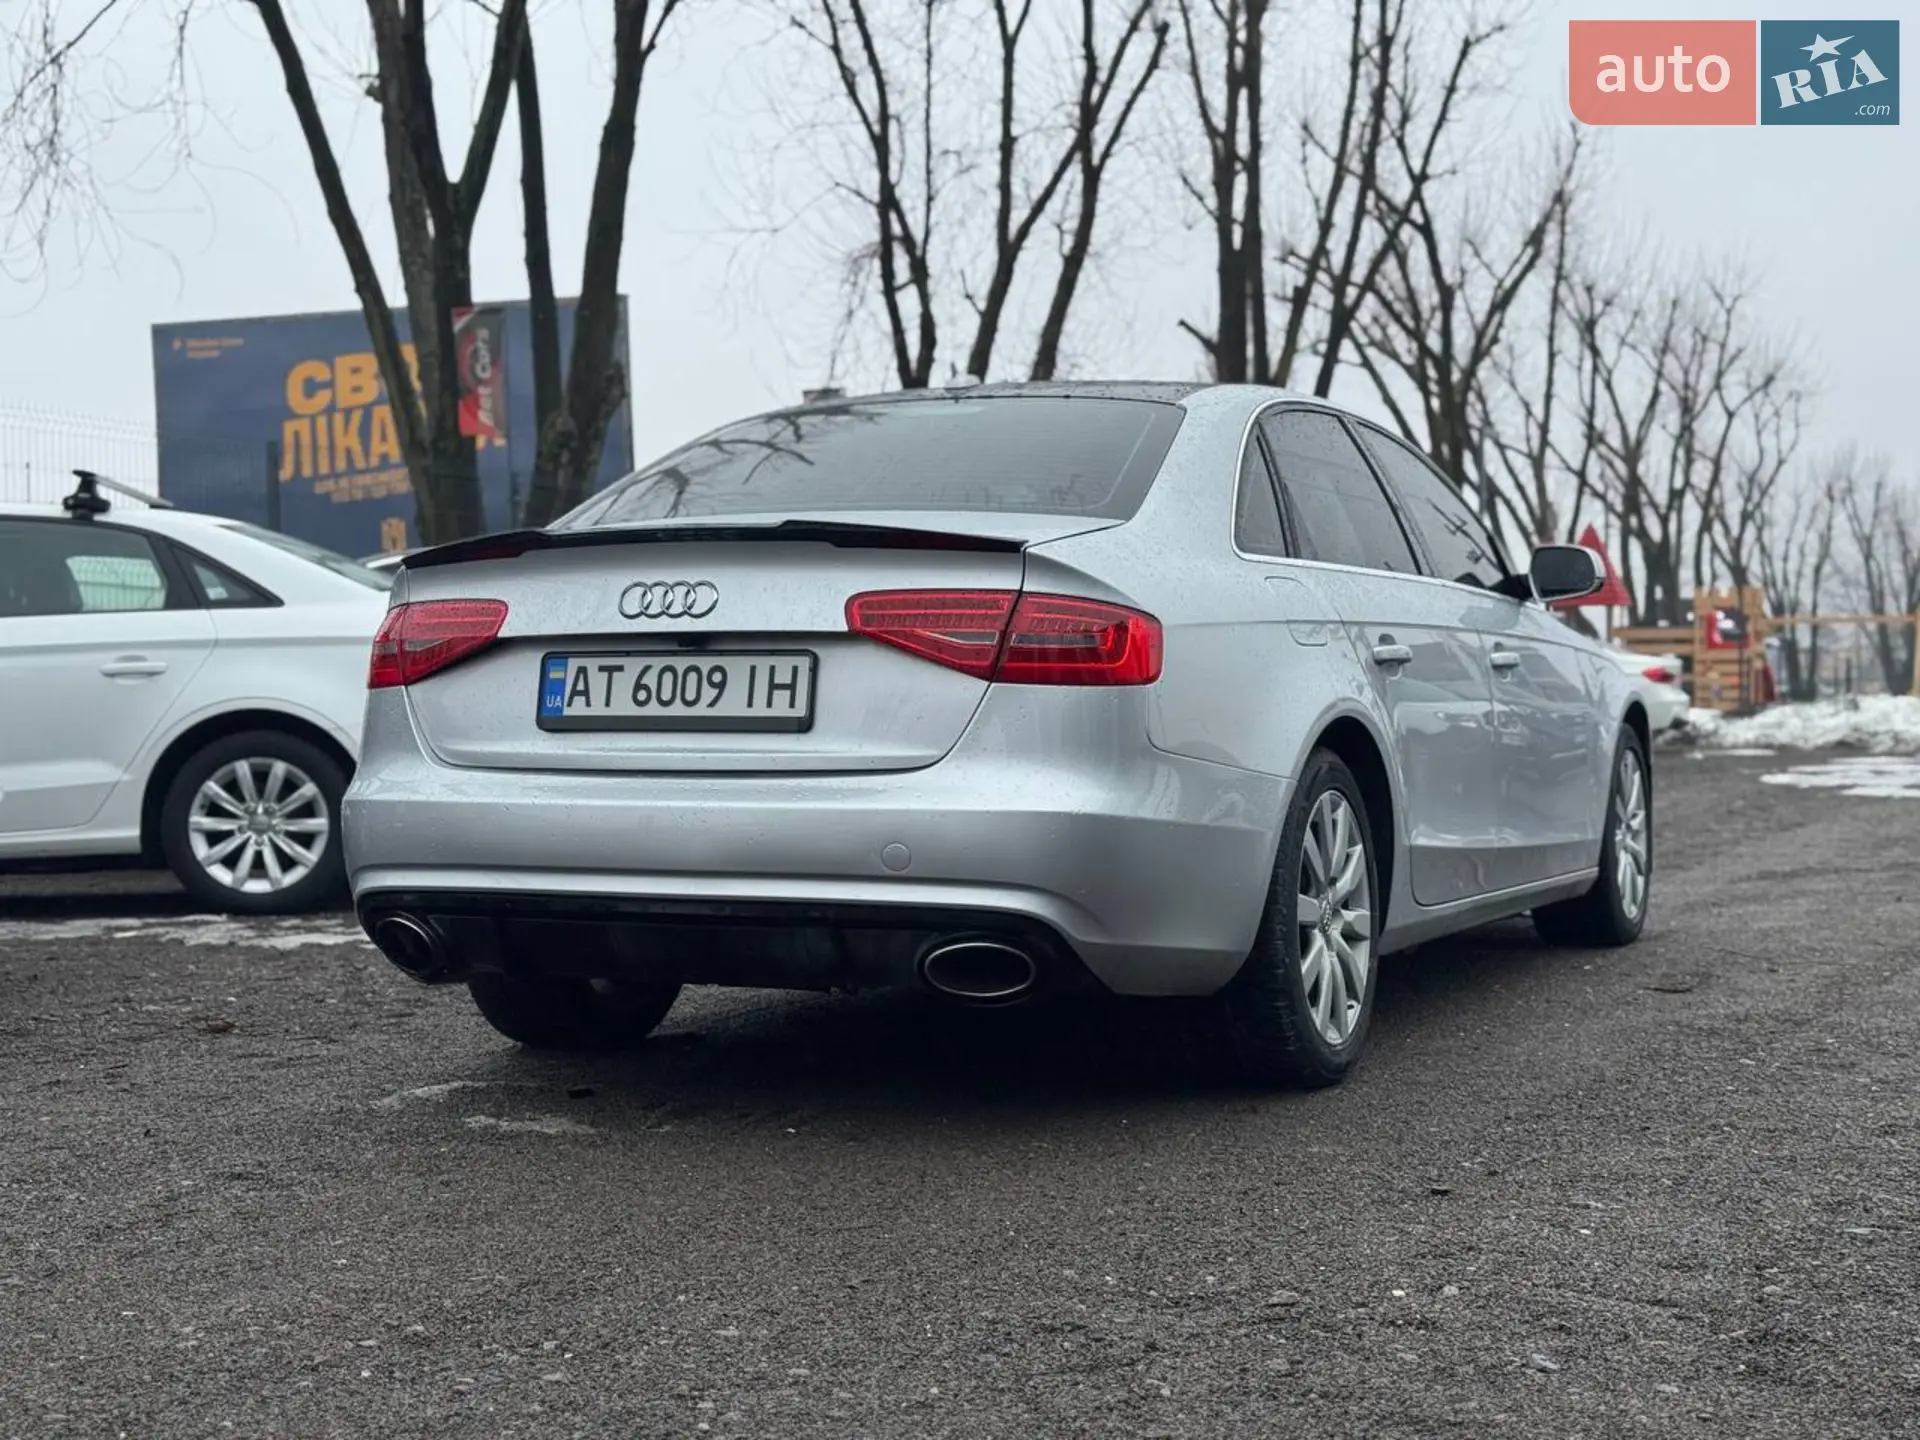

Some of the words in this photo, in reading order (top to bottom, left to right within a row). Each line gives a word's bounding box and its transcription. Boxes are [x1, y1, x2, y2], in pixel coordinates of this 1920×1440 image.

[279, 403, 408, 482] ЛІКА
[546, 695, 562, 708] UA
[566, 664, 625, 708] AT
[631, 664, 728, 708] 6009
[746, 664, 799, 709] IH
